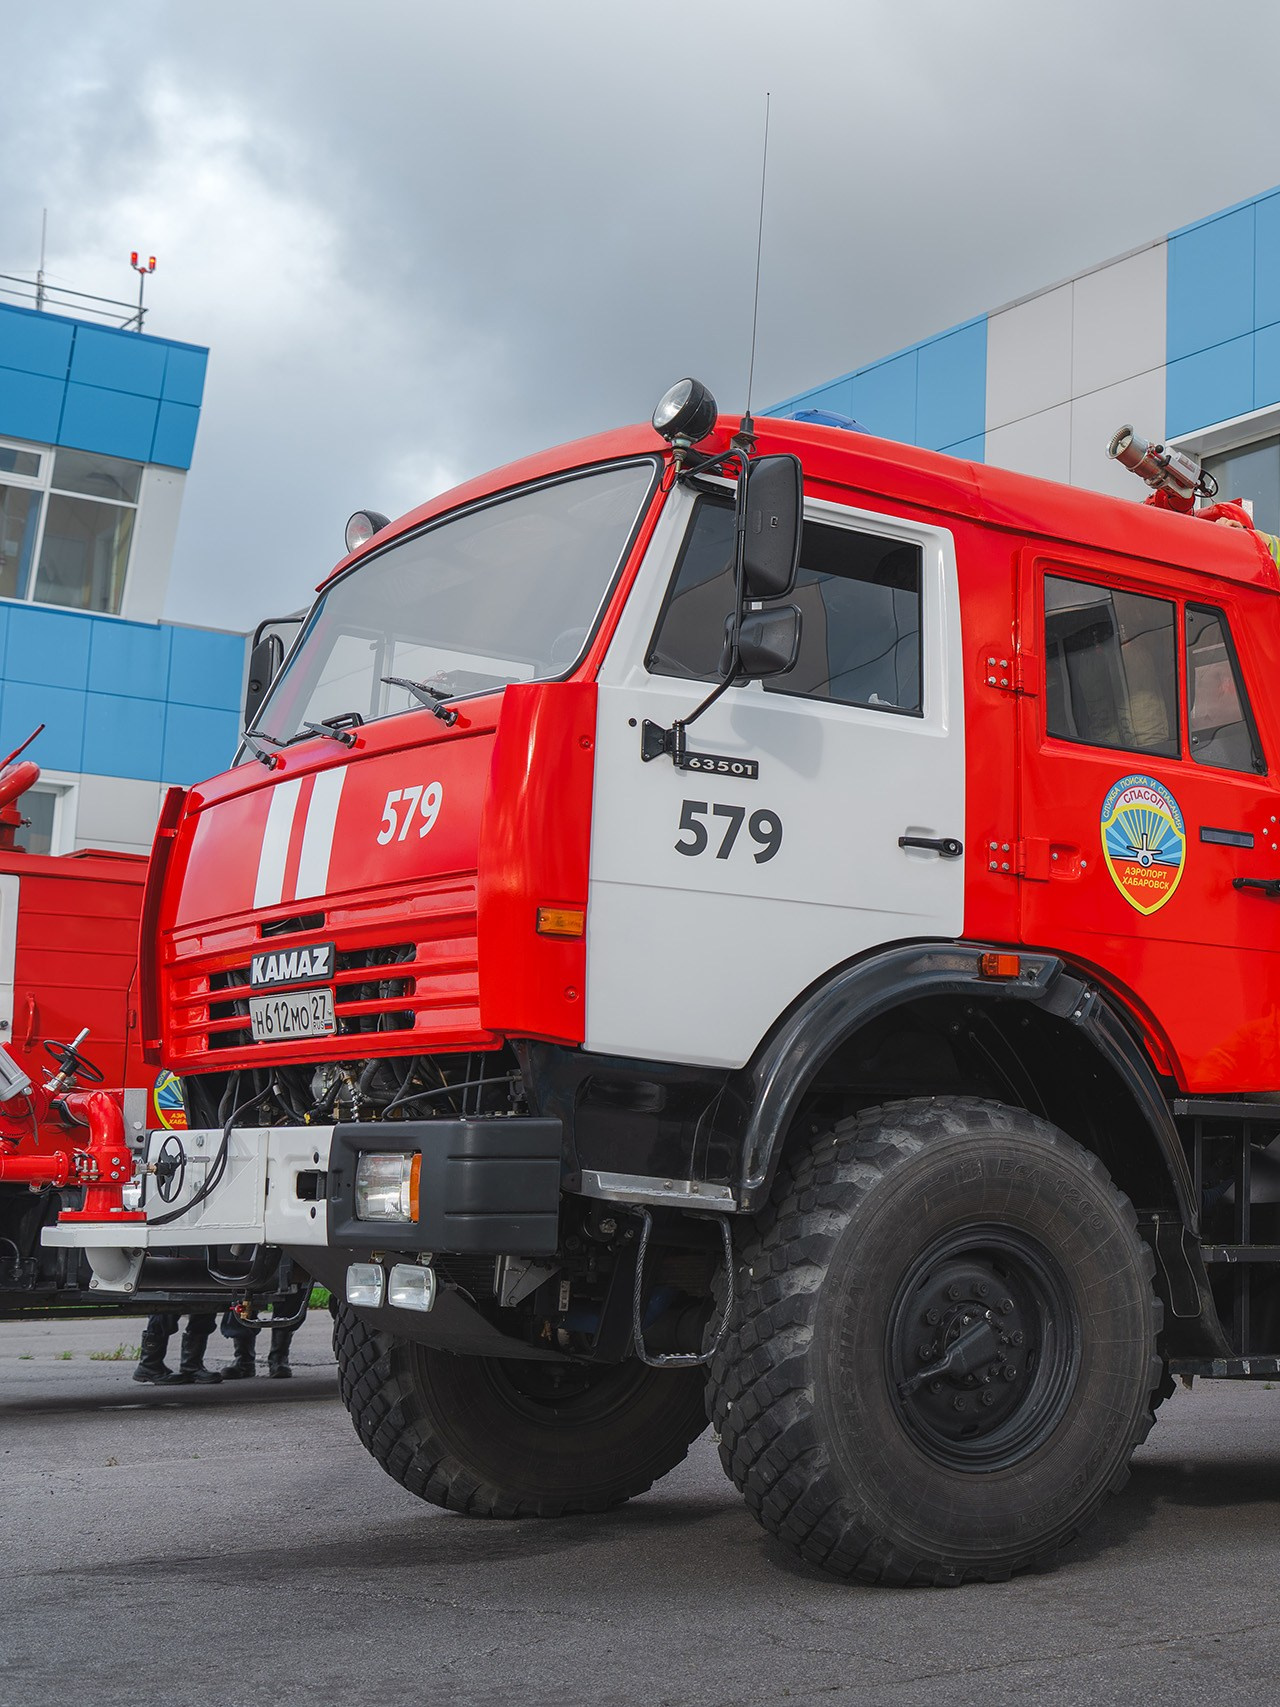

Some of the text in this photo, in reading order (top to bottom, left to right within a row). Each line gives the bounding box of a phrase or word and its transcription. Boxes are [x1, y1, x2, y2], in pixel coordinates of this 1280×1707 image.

[688, 757, 753, 776] 63501
[1103, 776, 1182, 829] СЛУЖБА ПОИСКА И СПАСАНИЯ
[1123, 789, 1164, 809] СПАСОП
[376, 781, 443, 846] 579
[674, 799, 783, 864] 579
[1122, 876, 1169, 890] ХАБАРОВСК
[1124, 866, 1167, 880] АЭРОПОРТ
[252, 946, 329, 985] KAMAZ
[311, 995, 326, 1020] 27
[312, 1020, 325, 1030] RUS
